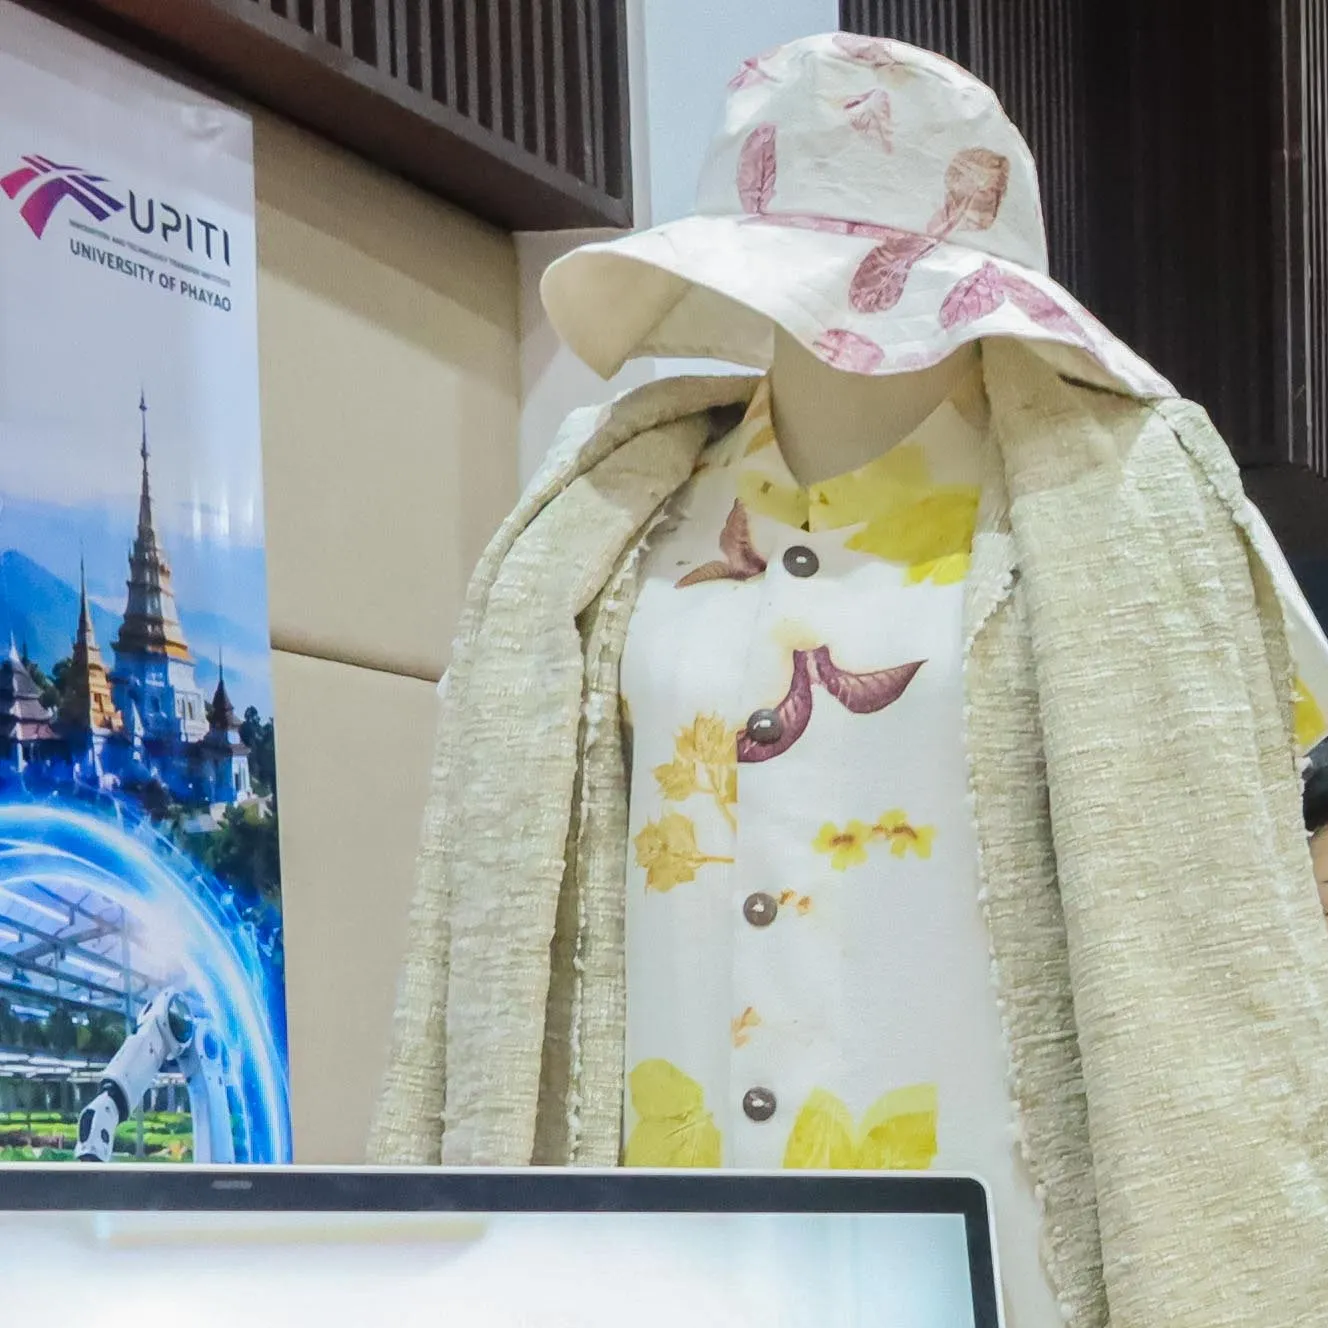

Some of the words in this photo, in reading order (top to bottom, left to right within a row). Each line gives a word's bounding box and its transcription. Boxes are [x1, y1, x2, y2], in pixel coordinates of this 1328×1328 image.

[129, 189, 231, 267] UPITI
[69, 238, 154, 283] UNIVERSITY
[158, 272, 176, 292] OF
[180, 279, 232, 312] PHAYAO
